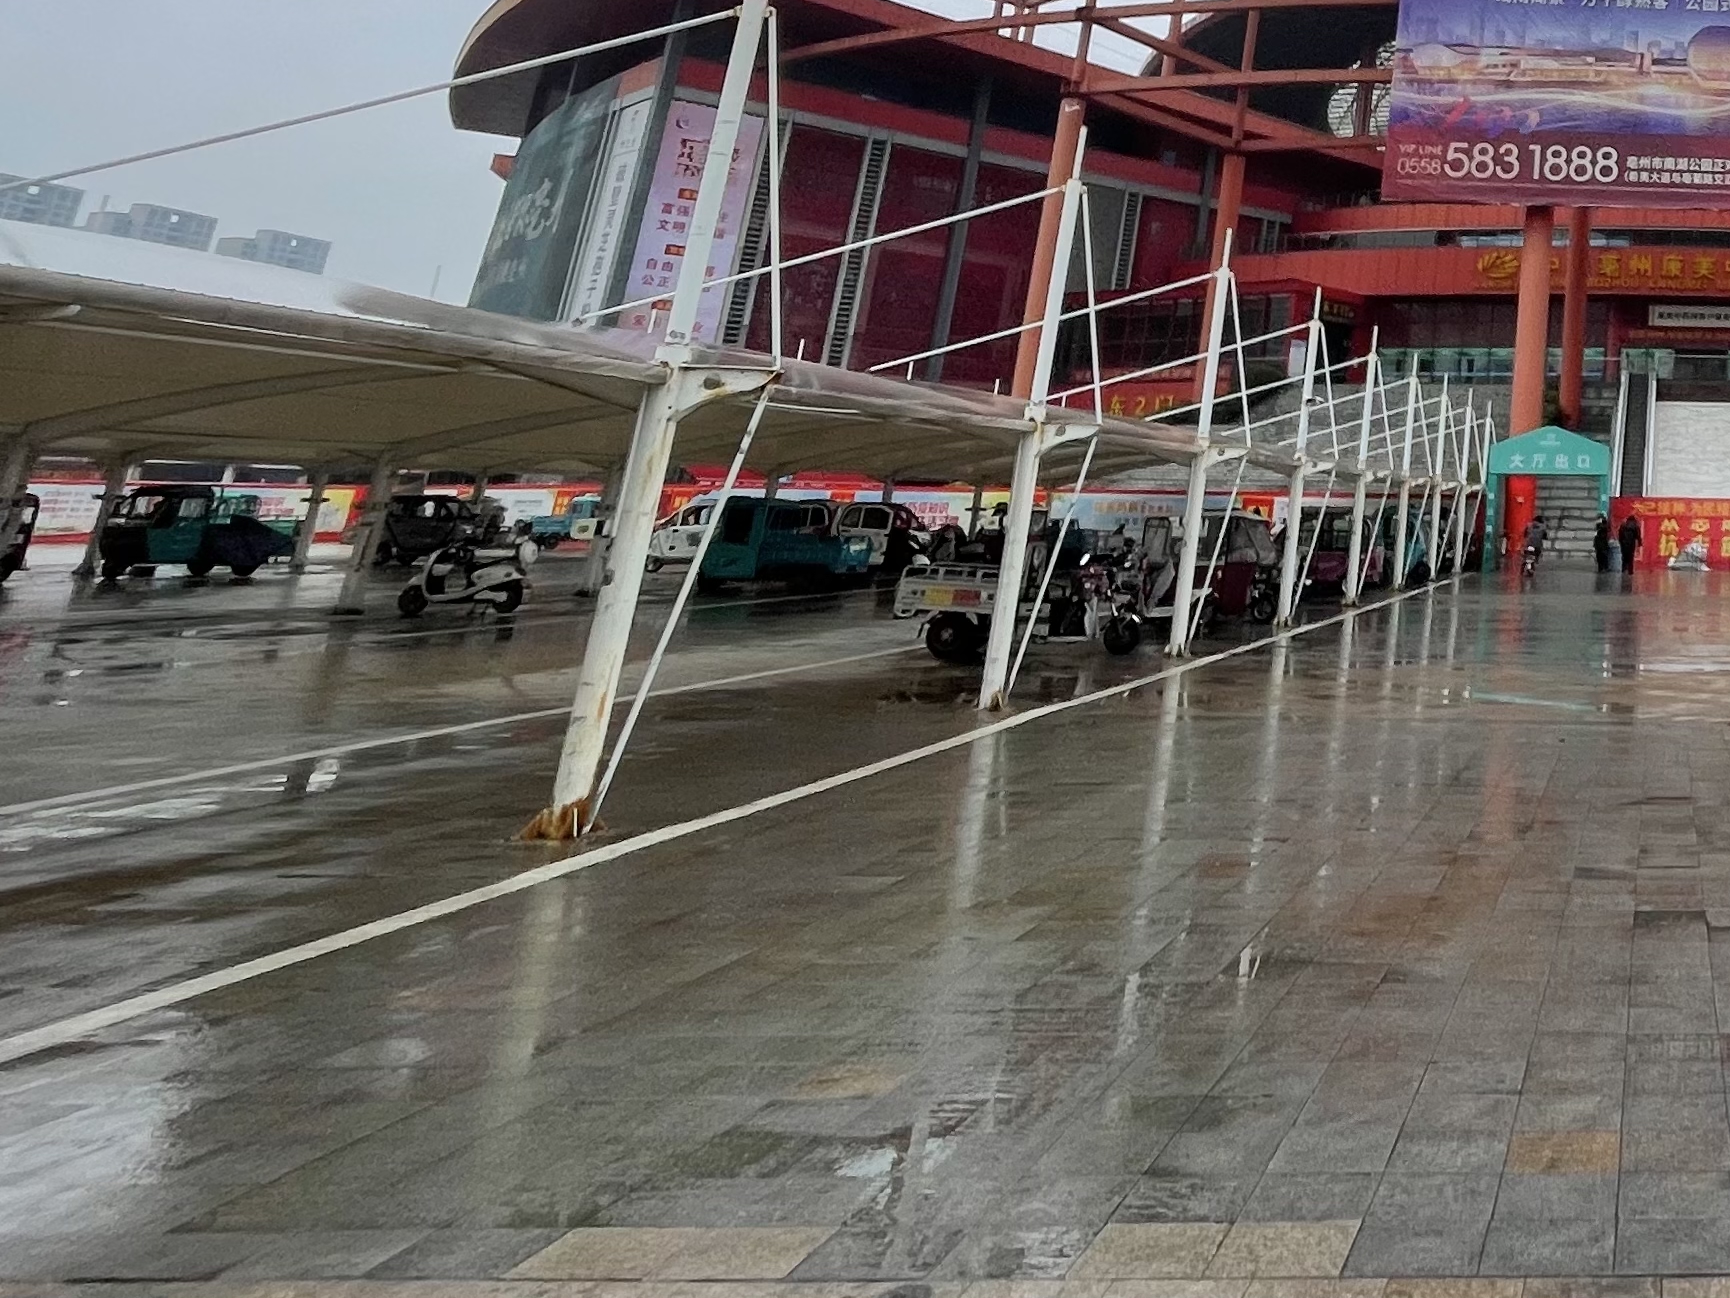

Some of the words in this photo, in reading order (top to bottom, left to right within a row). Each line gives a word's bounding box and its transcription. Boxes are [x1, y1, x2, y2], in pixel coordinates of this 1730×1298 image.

[1397, 158, 1441, 175] 0558
[661, 202, 694, 217] 富强
[656, 219, 687, 233] 文明
[645, 258, 674, 273] 自由
[641, 273, 671, 288] 公正
[1508, 453, 1591, 469] 大厅出口
